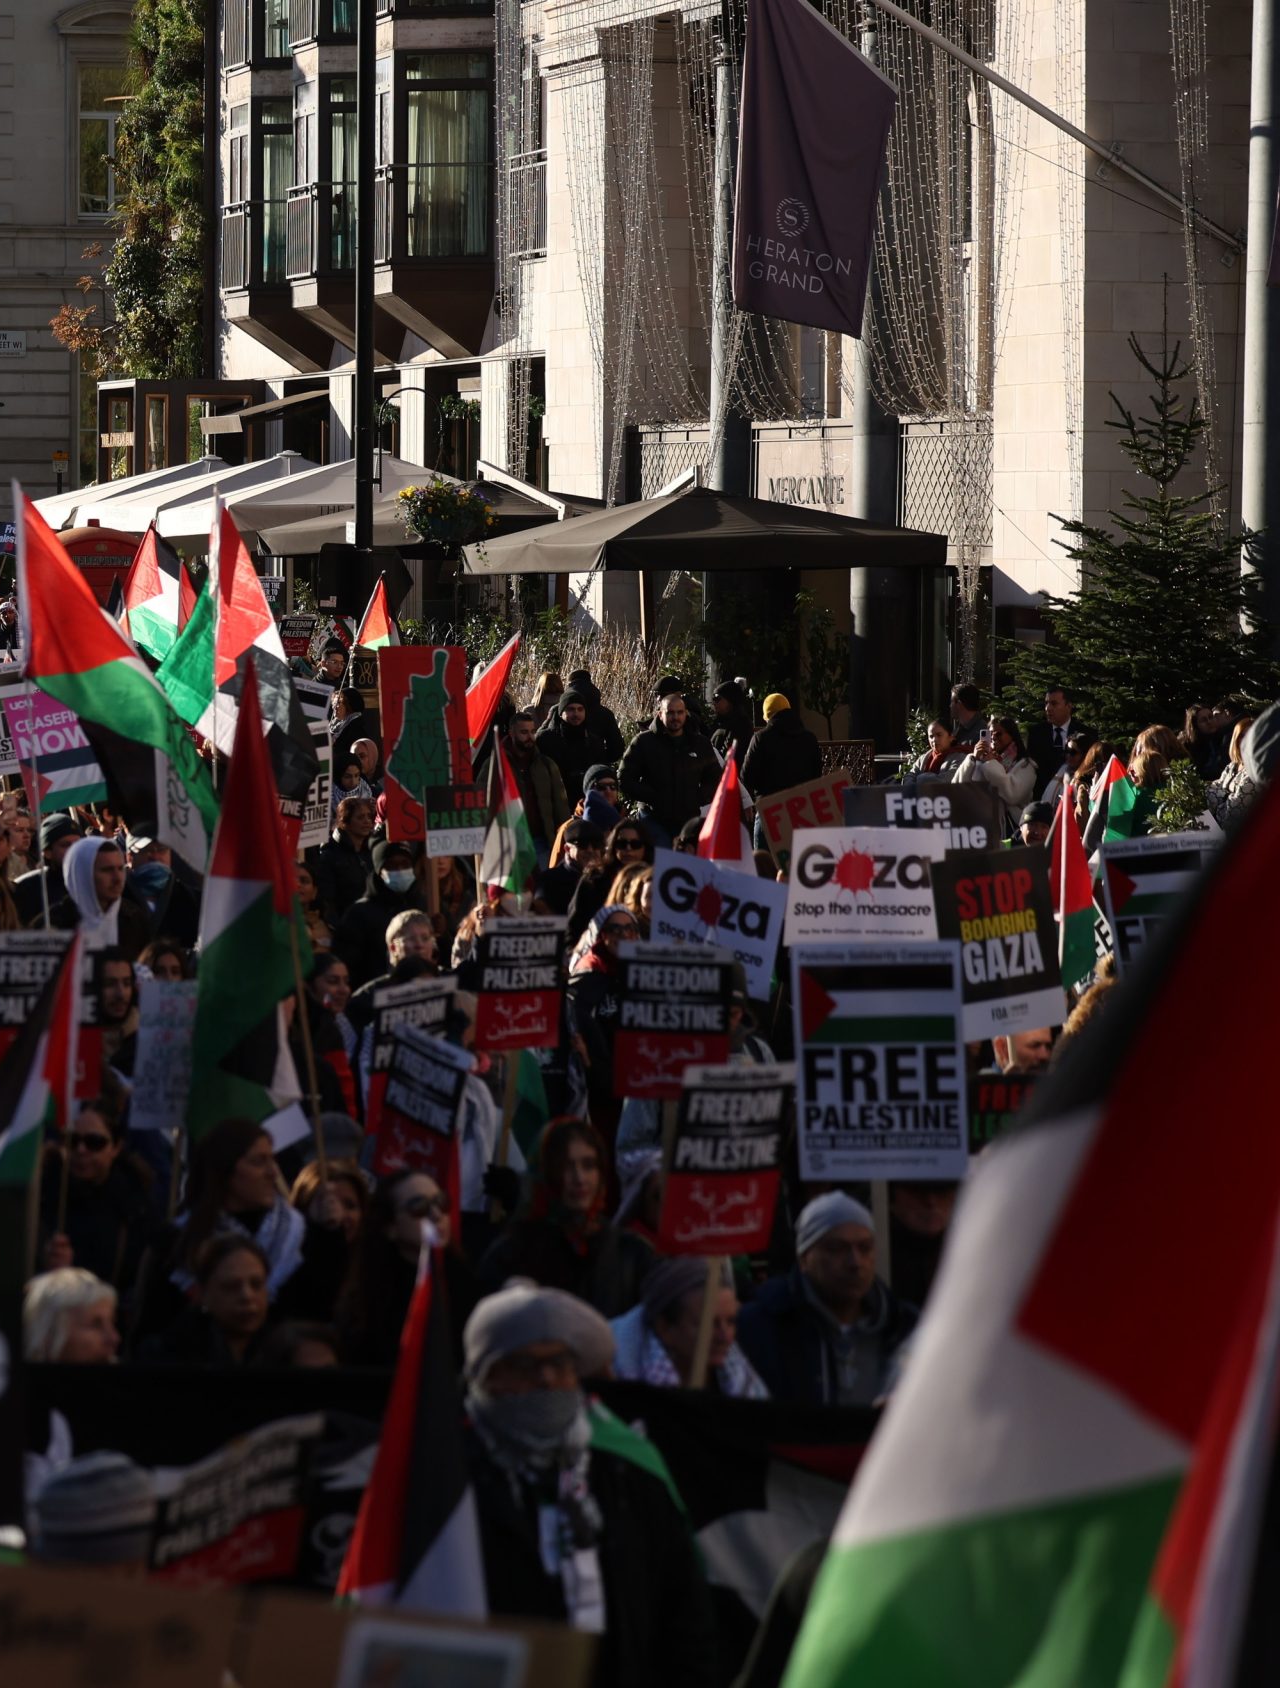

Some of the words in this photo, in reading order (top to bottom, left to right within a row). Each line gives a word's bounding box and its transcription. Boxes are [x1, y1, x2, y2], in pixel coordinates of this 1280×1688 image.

[746, 234, 852, 276] HERATON
[748, 260, 824, 294] GRAND
[768, 477, 845, 505] MERCANTE
[286, 620, 313, 629] FREEDOM
[14, 710, 80, 734] CEASEFI
[453, 790, 487, 809] FRE
[884, 791, 952, 821] Free
[796, 843, 932, 890] Gza
[658, 866, 771, 940] Gza
[954, 868, 1034, 921] STOP
[794, 902, 824, 918] Stop
[828, 902, 852, 916] the
[856, 903, 932, 917] massacre
[657, 921, 686, 940] Stop
[960, 908, 1038, 944] BOMBING
[488, 934, 558, 959] FREEDOM
[962, 931, 1044, 986] GAZA
[482, 964, 560, 990] PALESTINE
[626, 963, 721, 992] FREEDOM
[621, 1000, 724, 1030] PALESTINE
[803, 1046, 960, 1102] FREE
[686, 1089, 784, 1124] FREEDOM
[804, 1104, 960, 1131] PALESTINE
[673, 1134, 780, 1171] PALESTINE
